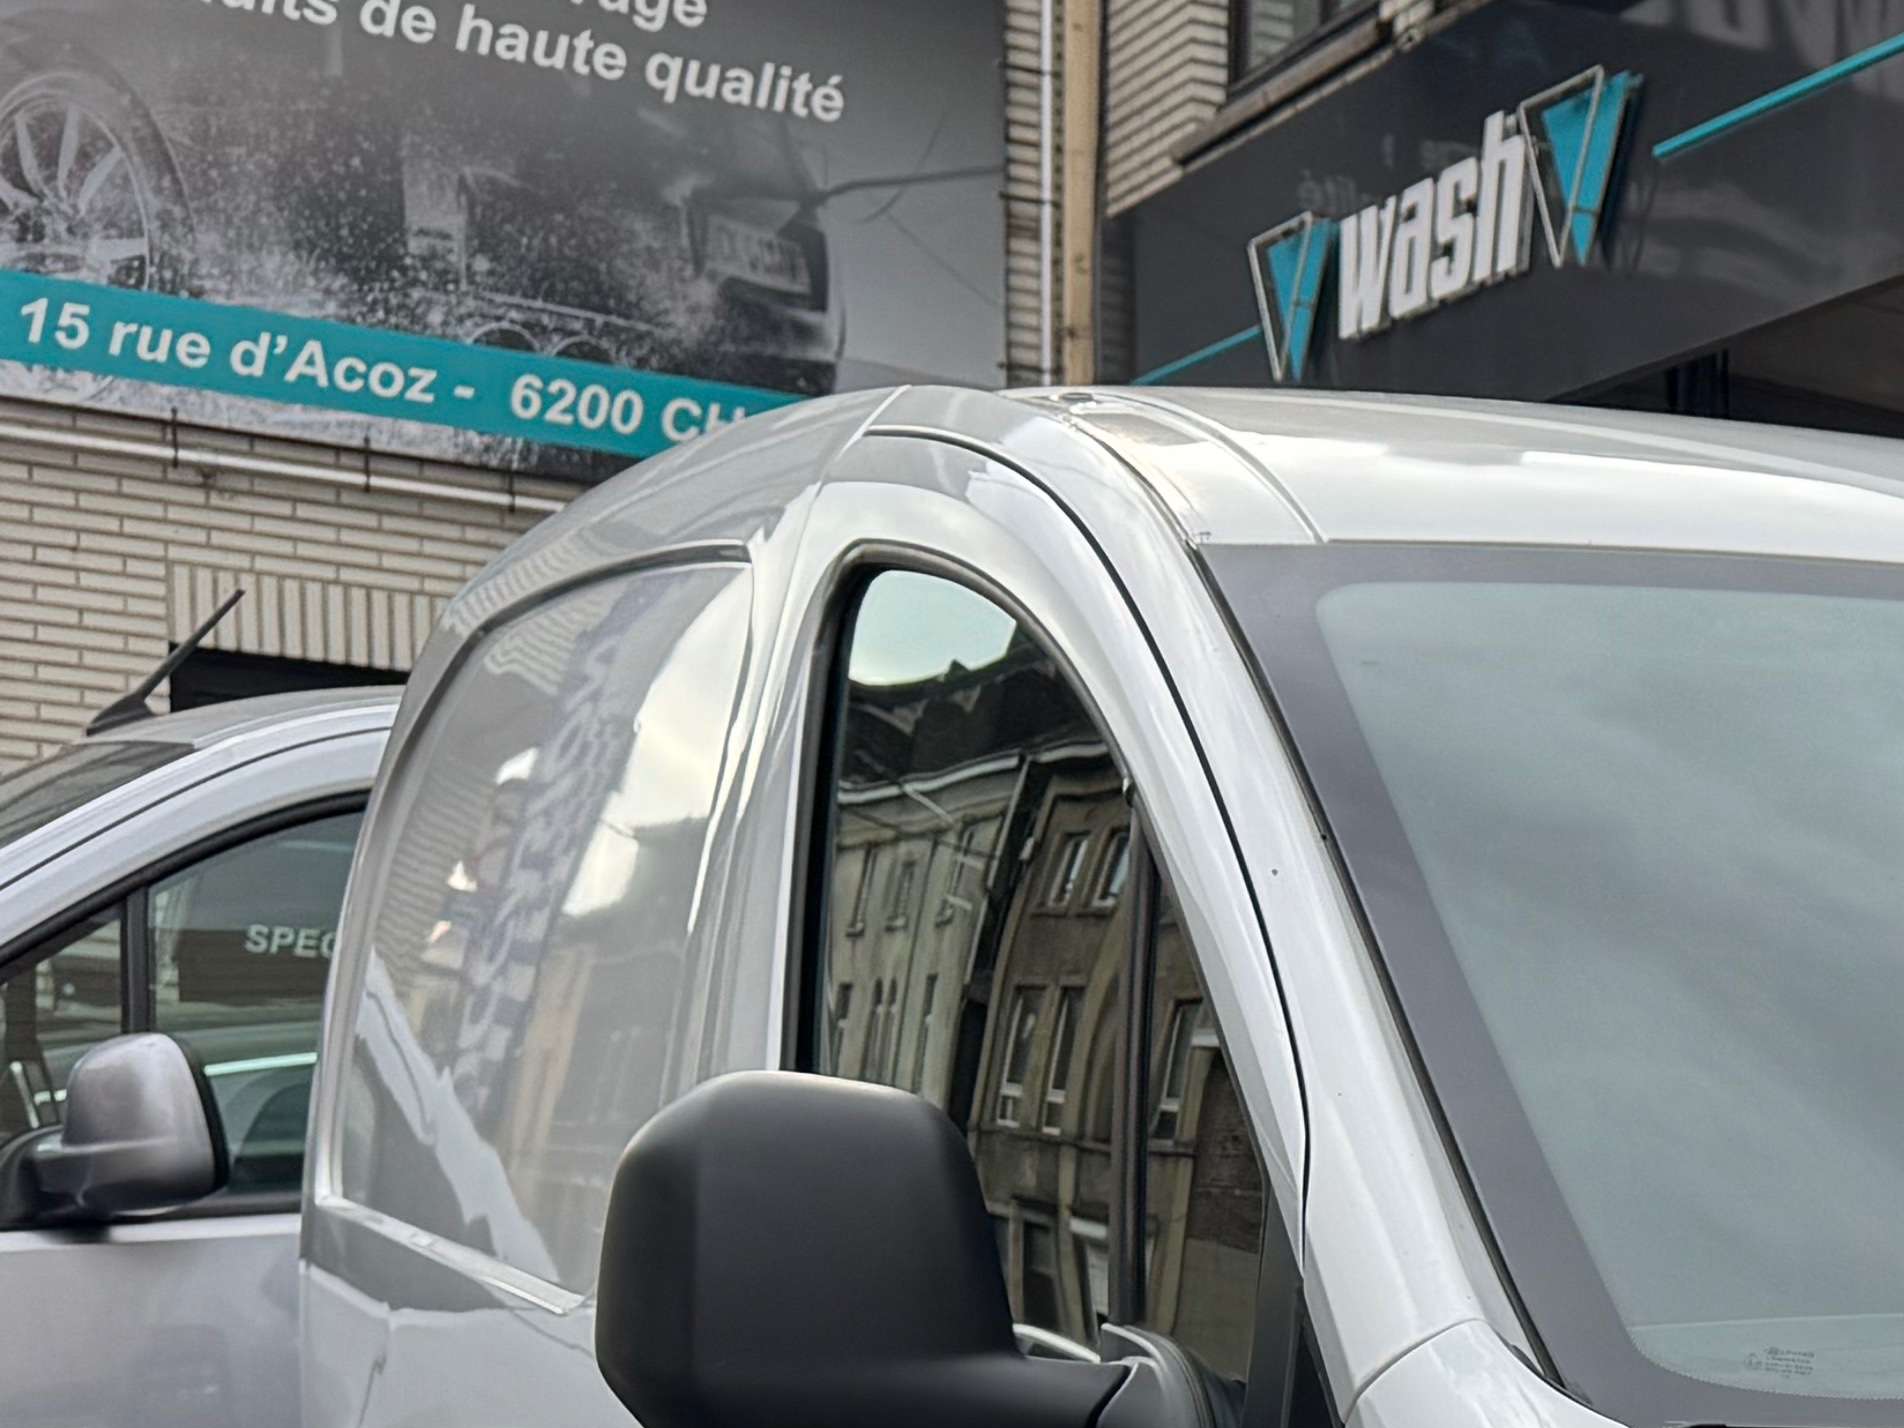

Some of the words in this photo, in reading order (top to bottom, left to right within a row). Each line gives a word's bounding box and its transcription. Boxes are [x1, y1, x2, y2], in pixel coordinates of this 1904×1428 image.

[359, 0, 436, 43] de
[455, 3, 627, 80] haute
[645, 51, 844, 122] qualité
[1338, 110, 1530, 339] wash
[20, 297, 90, 350] 15
[108, 320, 211, 368] rue
[230, 331, 438, 403] d'Acoz
[510, 373, 644, 435] 6200
